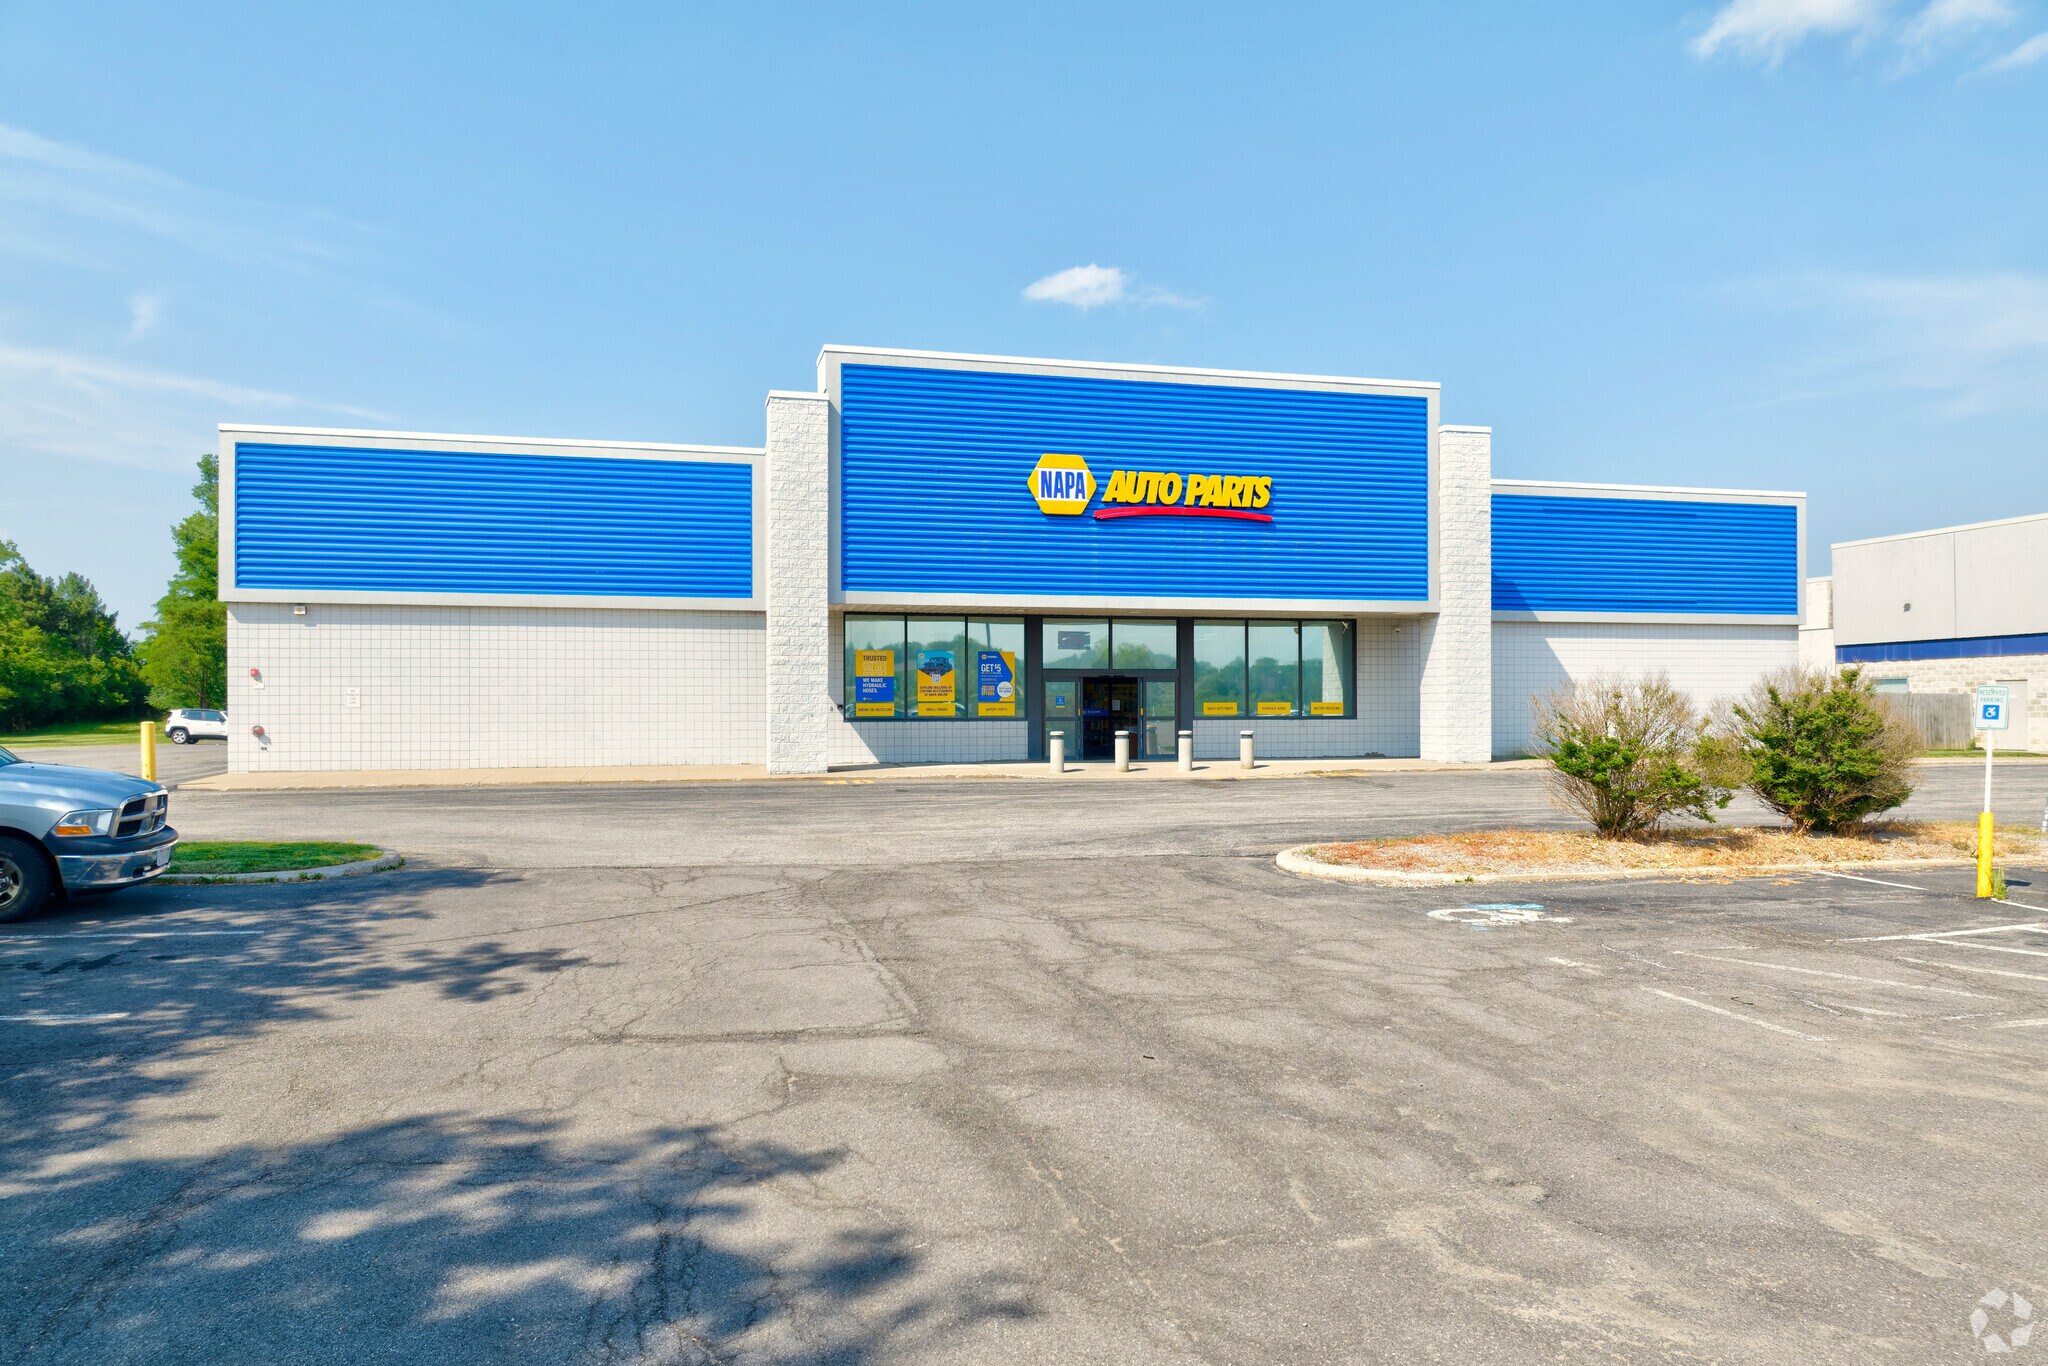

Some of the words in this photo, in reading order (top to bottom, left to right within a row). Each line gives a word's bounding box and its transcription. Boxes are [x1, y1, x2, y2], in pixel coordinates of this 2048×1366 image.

[1040, 470, 1086, 500] NAPA
[1102, 470, 1183, 505] AUTO
[1184, 473, 1272, 508] PARTS
[981, 663, 994, 672] GET
